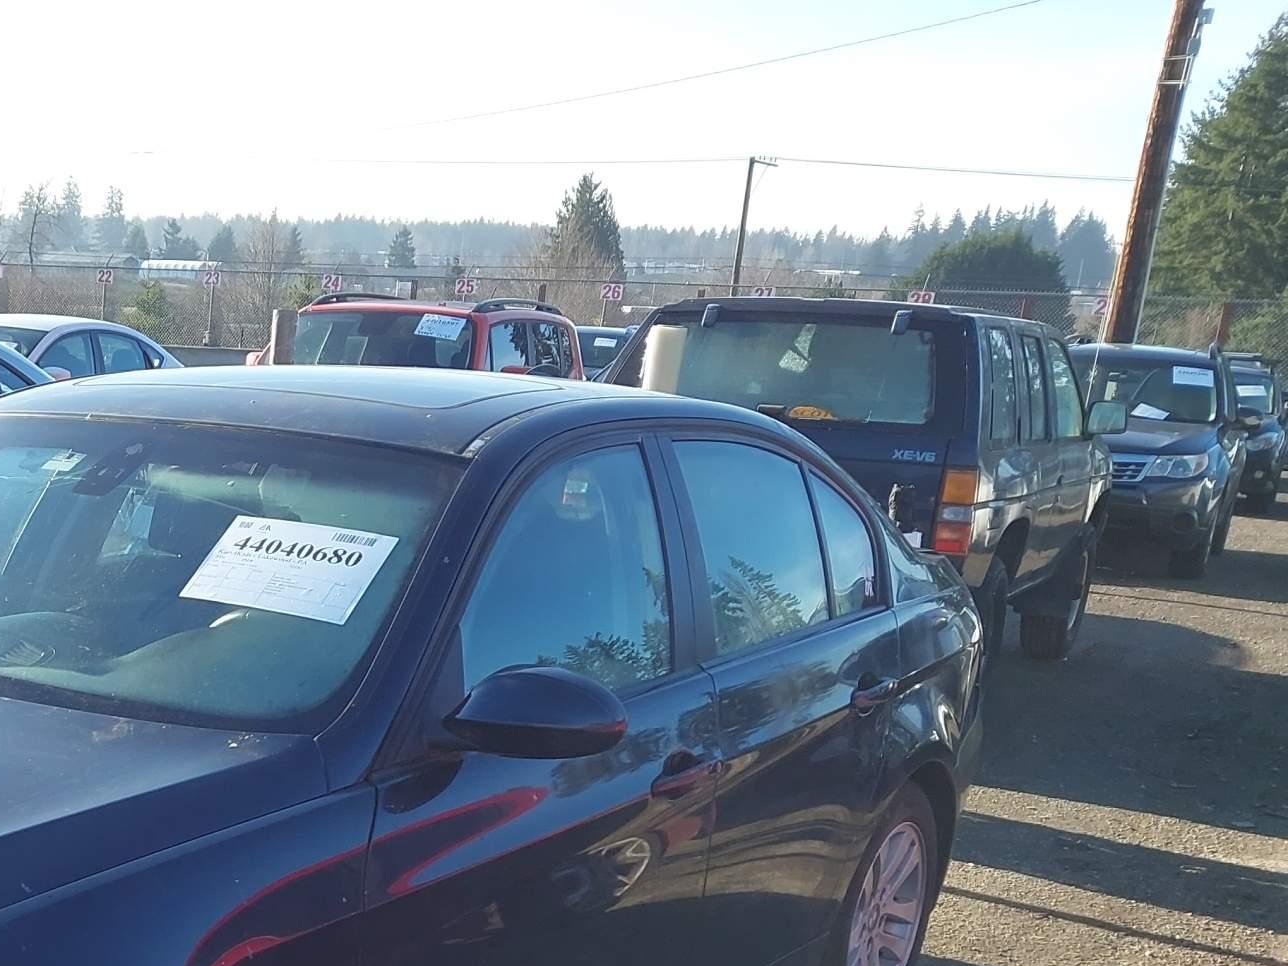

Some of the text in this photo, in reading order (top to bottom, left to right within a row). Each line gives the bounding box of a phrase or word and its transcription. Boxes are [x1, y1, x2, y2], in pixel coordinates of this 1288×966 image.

[98, 270, 112, 283] 22
[205, 272, 220, 285] 23
[324, 276, 340, 289] 24
[456, 279, 474, 294] 25
[601, 285, 621, 299] 26
[233, 536, 363, 567] 44040680
